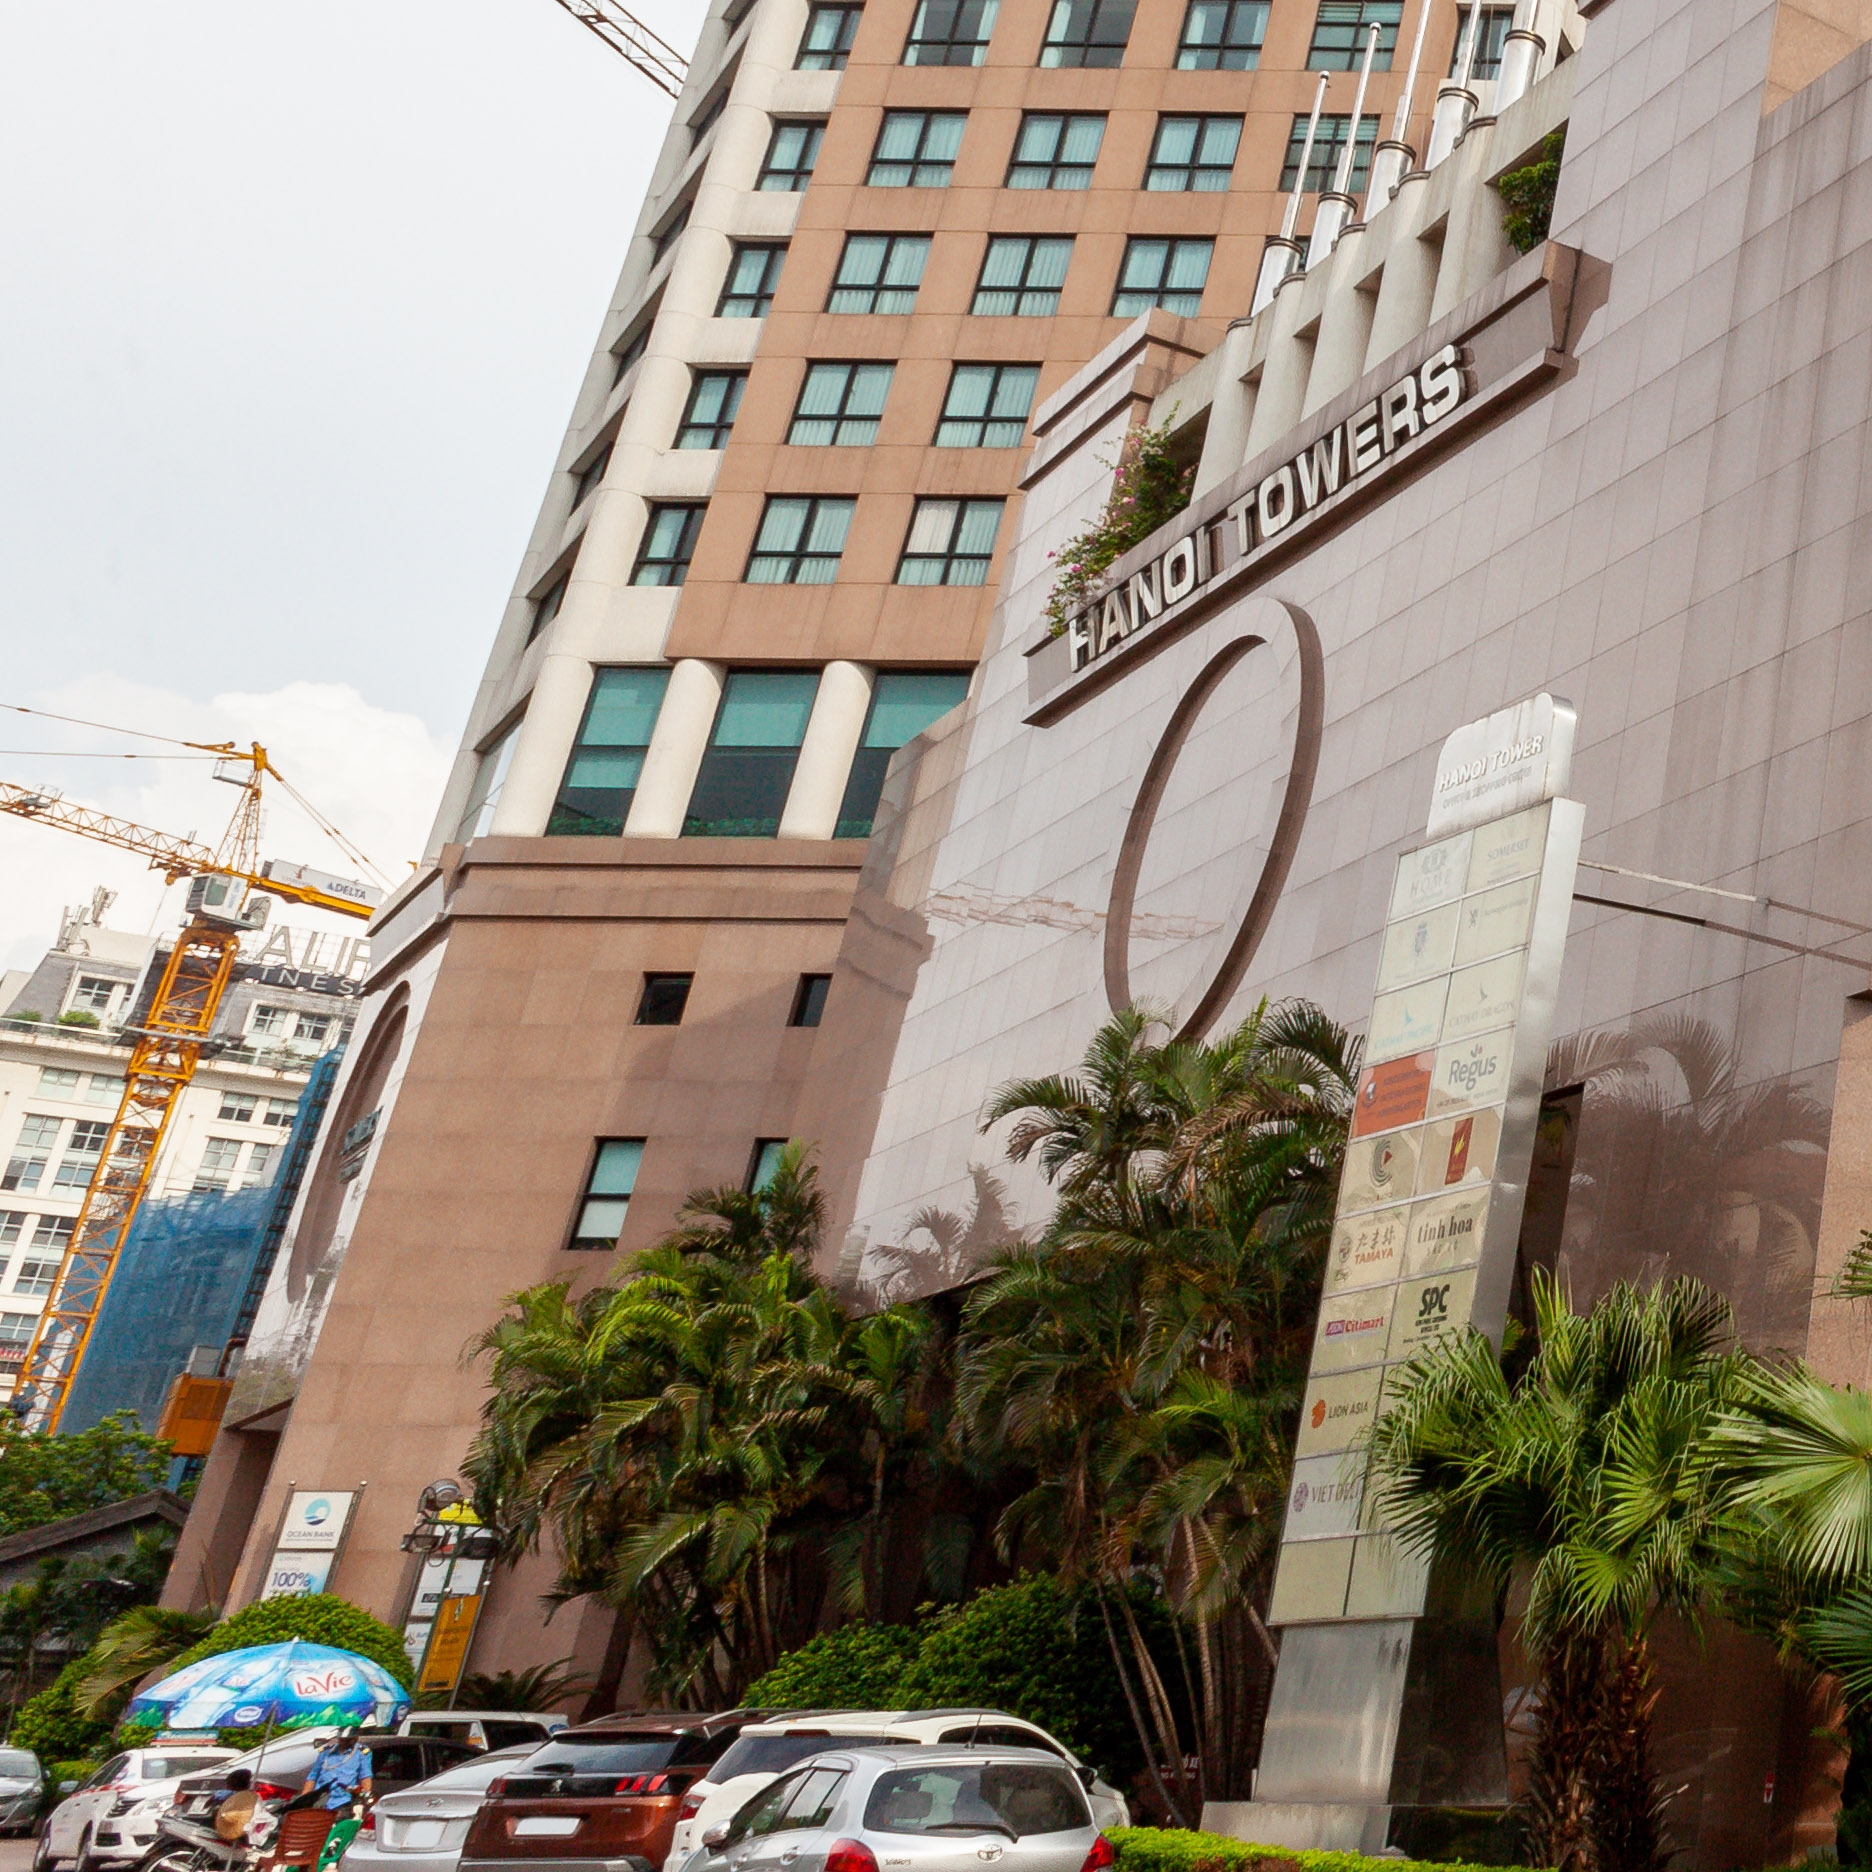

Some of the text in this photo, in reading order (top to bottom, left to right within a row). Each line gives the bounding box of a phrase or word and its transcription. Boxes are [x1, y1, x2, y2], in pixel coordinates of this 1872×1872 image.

[1068, 344, 1464, 673] HANOI TOWERS
[1439, 735, 1544, 793] HANOI TOWER
[334, 883, 366, 900] DELTA
[1448, 1056, 1497, 1091] Regus
[1447, 1215, 1473, 1237] hoa
[1354, 1247, 1394, 1265] TAMAYA
[1418, 1284, 1450, 1317] SPC
[1345, 1316, 1384, 1333] Citimart
[1329, 1401, 1369, 1419] LION ASIA
[286, 1530, 312, 1538] OCEAN
[272, 1572, 311, 1587] 100%
